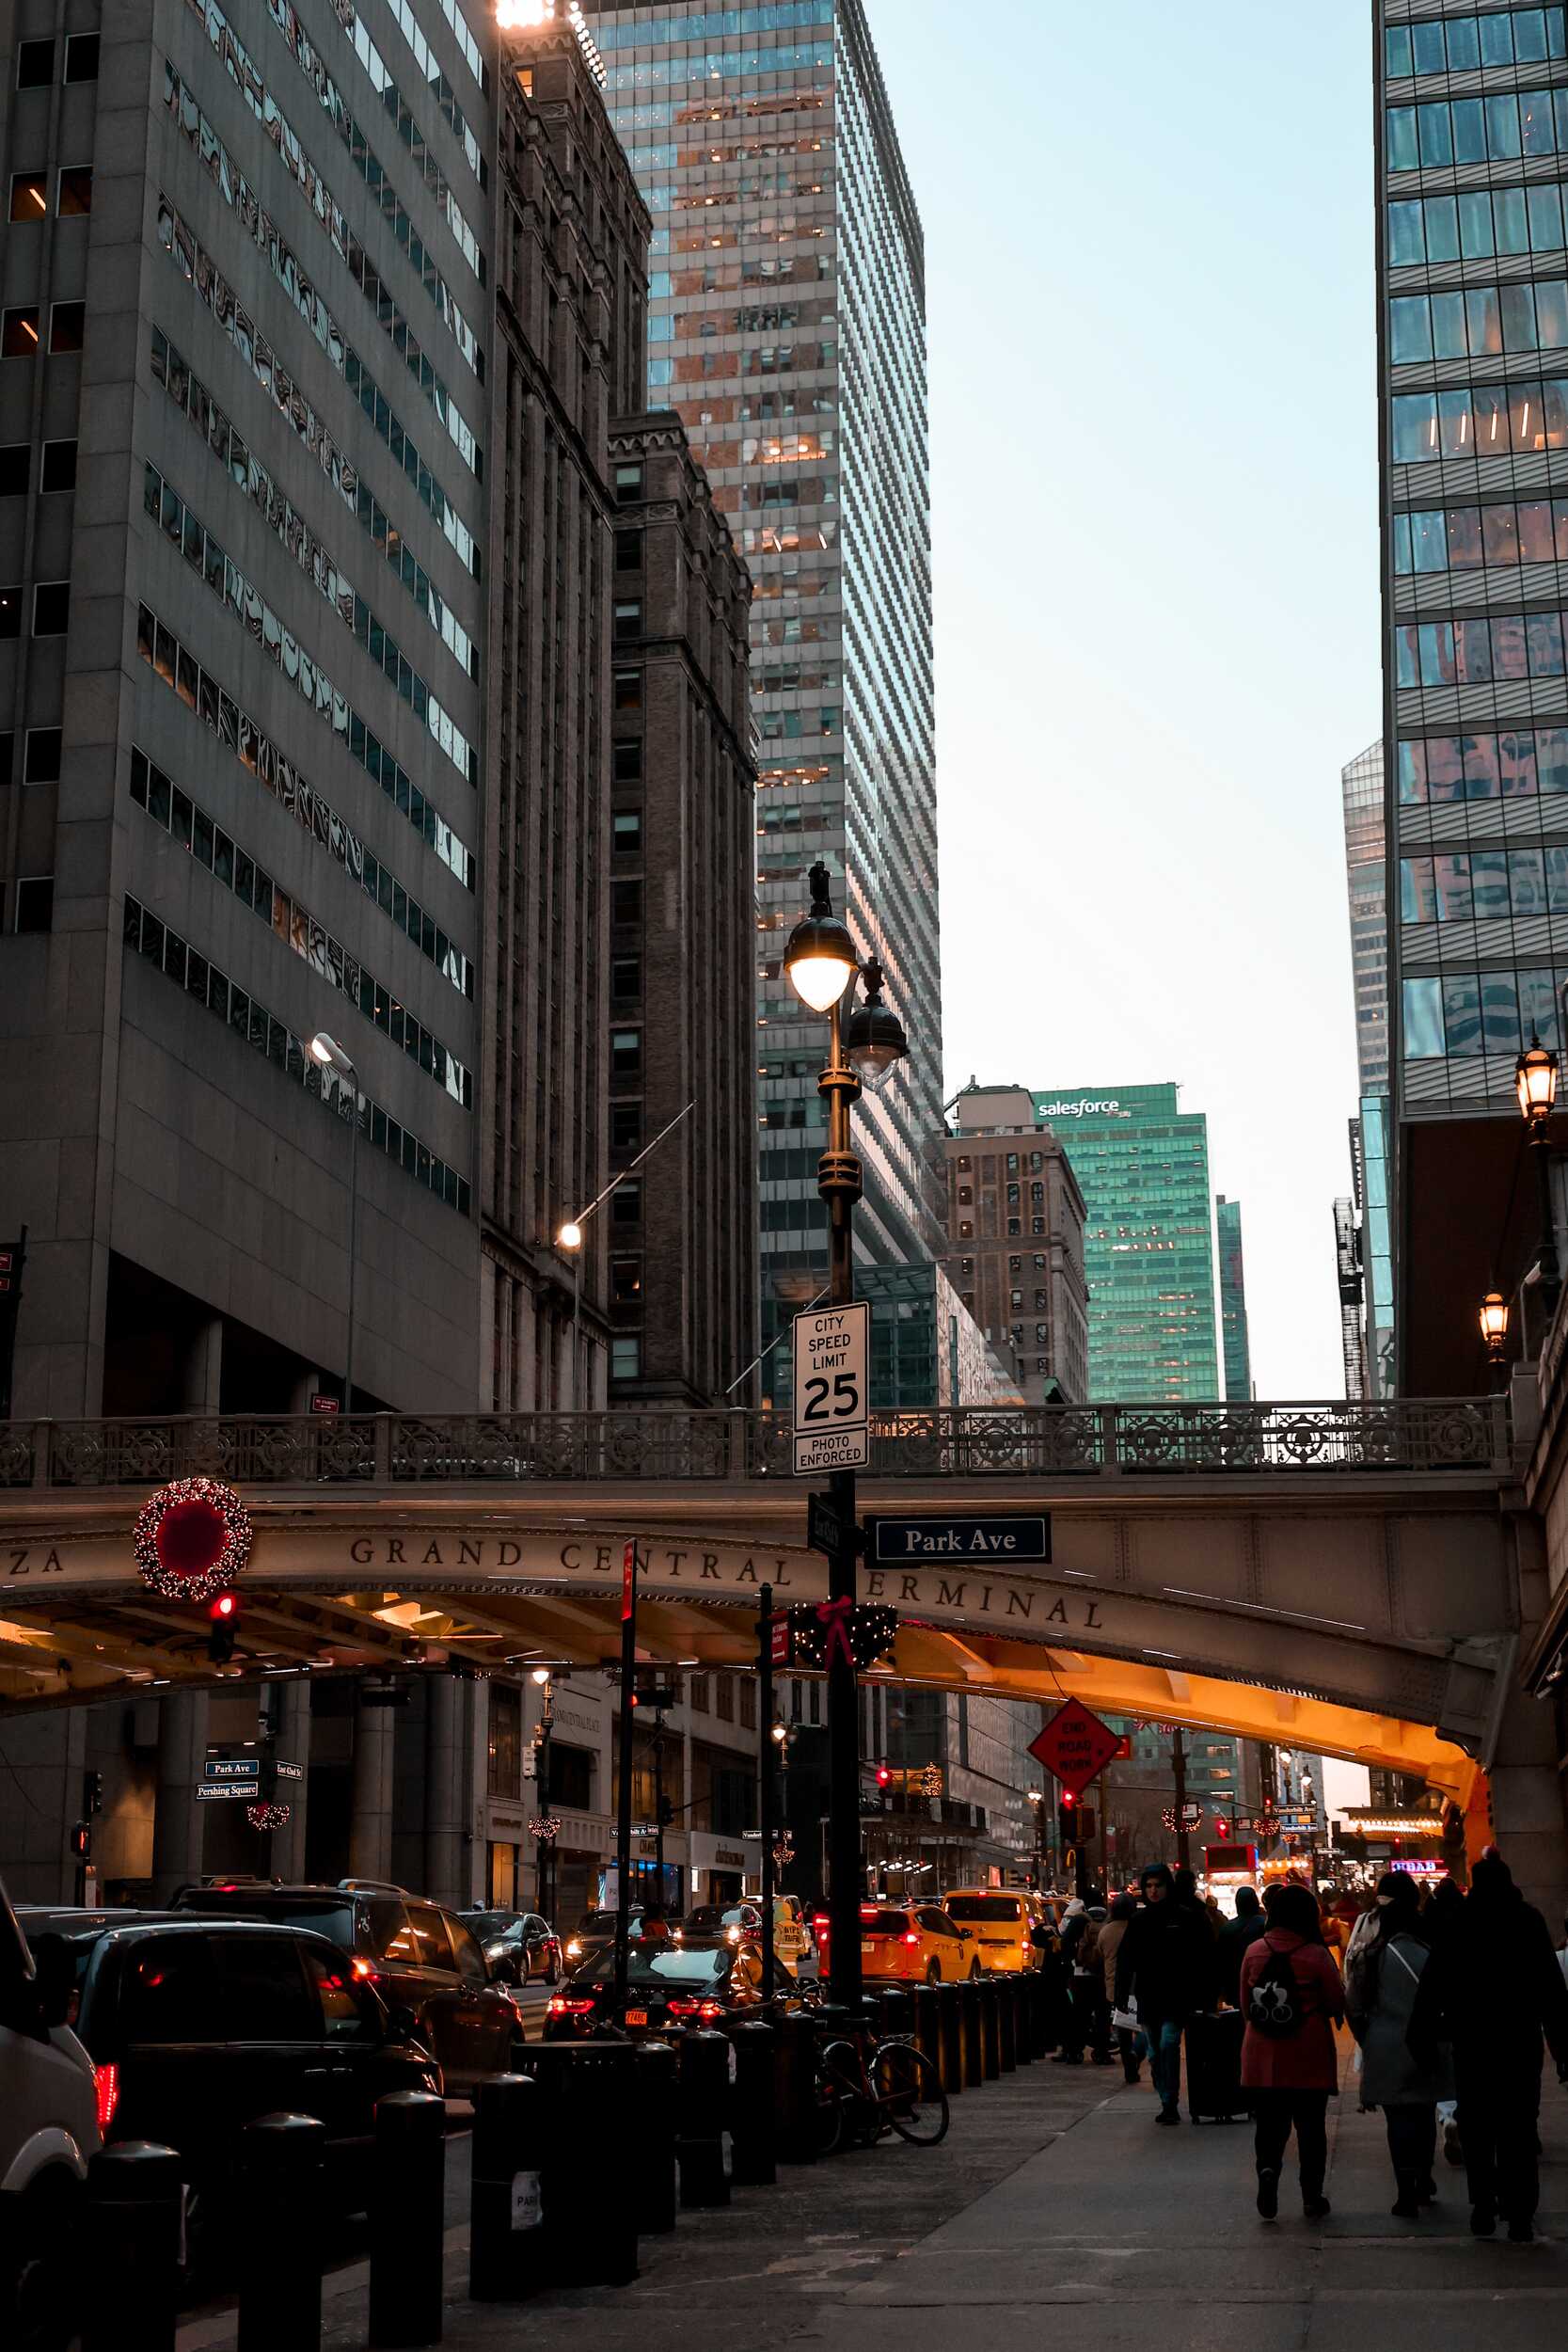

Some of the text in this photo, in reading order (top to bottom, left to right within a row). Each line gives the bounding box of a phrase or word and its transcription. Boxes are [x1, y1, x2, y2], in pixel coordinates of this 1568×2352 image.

[1038, 1099, 1119, 1118] salesforce
[815, 1315, 845, 1332] CITY
[809, 1334, 851, 1352] SPEED
[813, 1353, 847, 1370] LIMIT
[804, 1373, 858, 1421] 25
[812, 1436, 849, 1452] PHOTO
[800, 1448, 862, 1467] ENFORCED
[905, 1529, 1017, 1551] Park Ave
[351, 1538, 521, 1565] GRAND
[561, 1544, 791, 1585] CENTRAL
[866, 1571, 1102, 1629] ERMINAL
[1061, 1722, 1086, 1734] END
[1057, 1739, 1091, 1752] ROAD
[214, 1763, 250, 1773] Park Ave
[1059, 1758, 1092, 1772] WORK
[198, 1785, 256, 1796] Pershing Square
